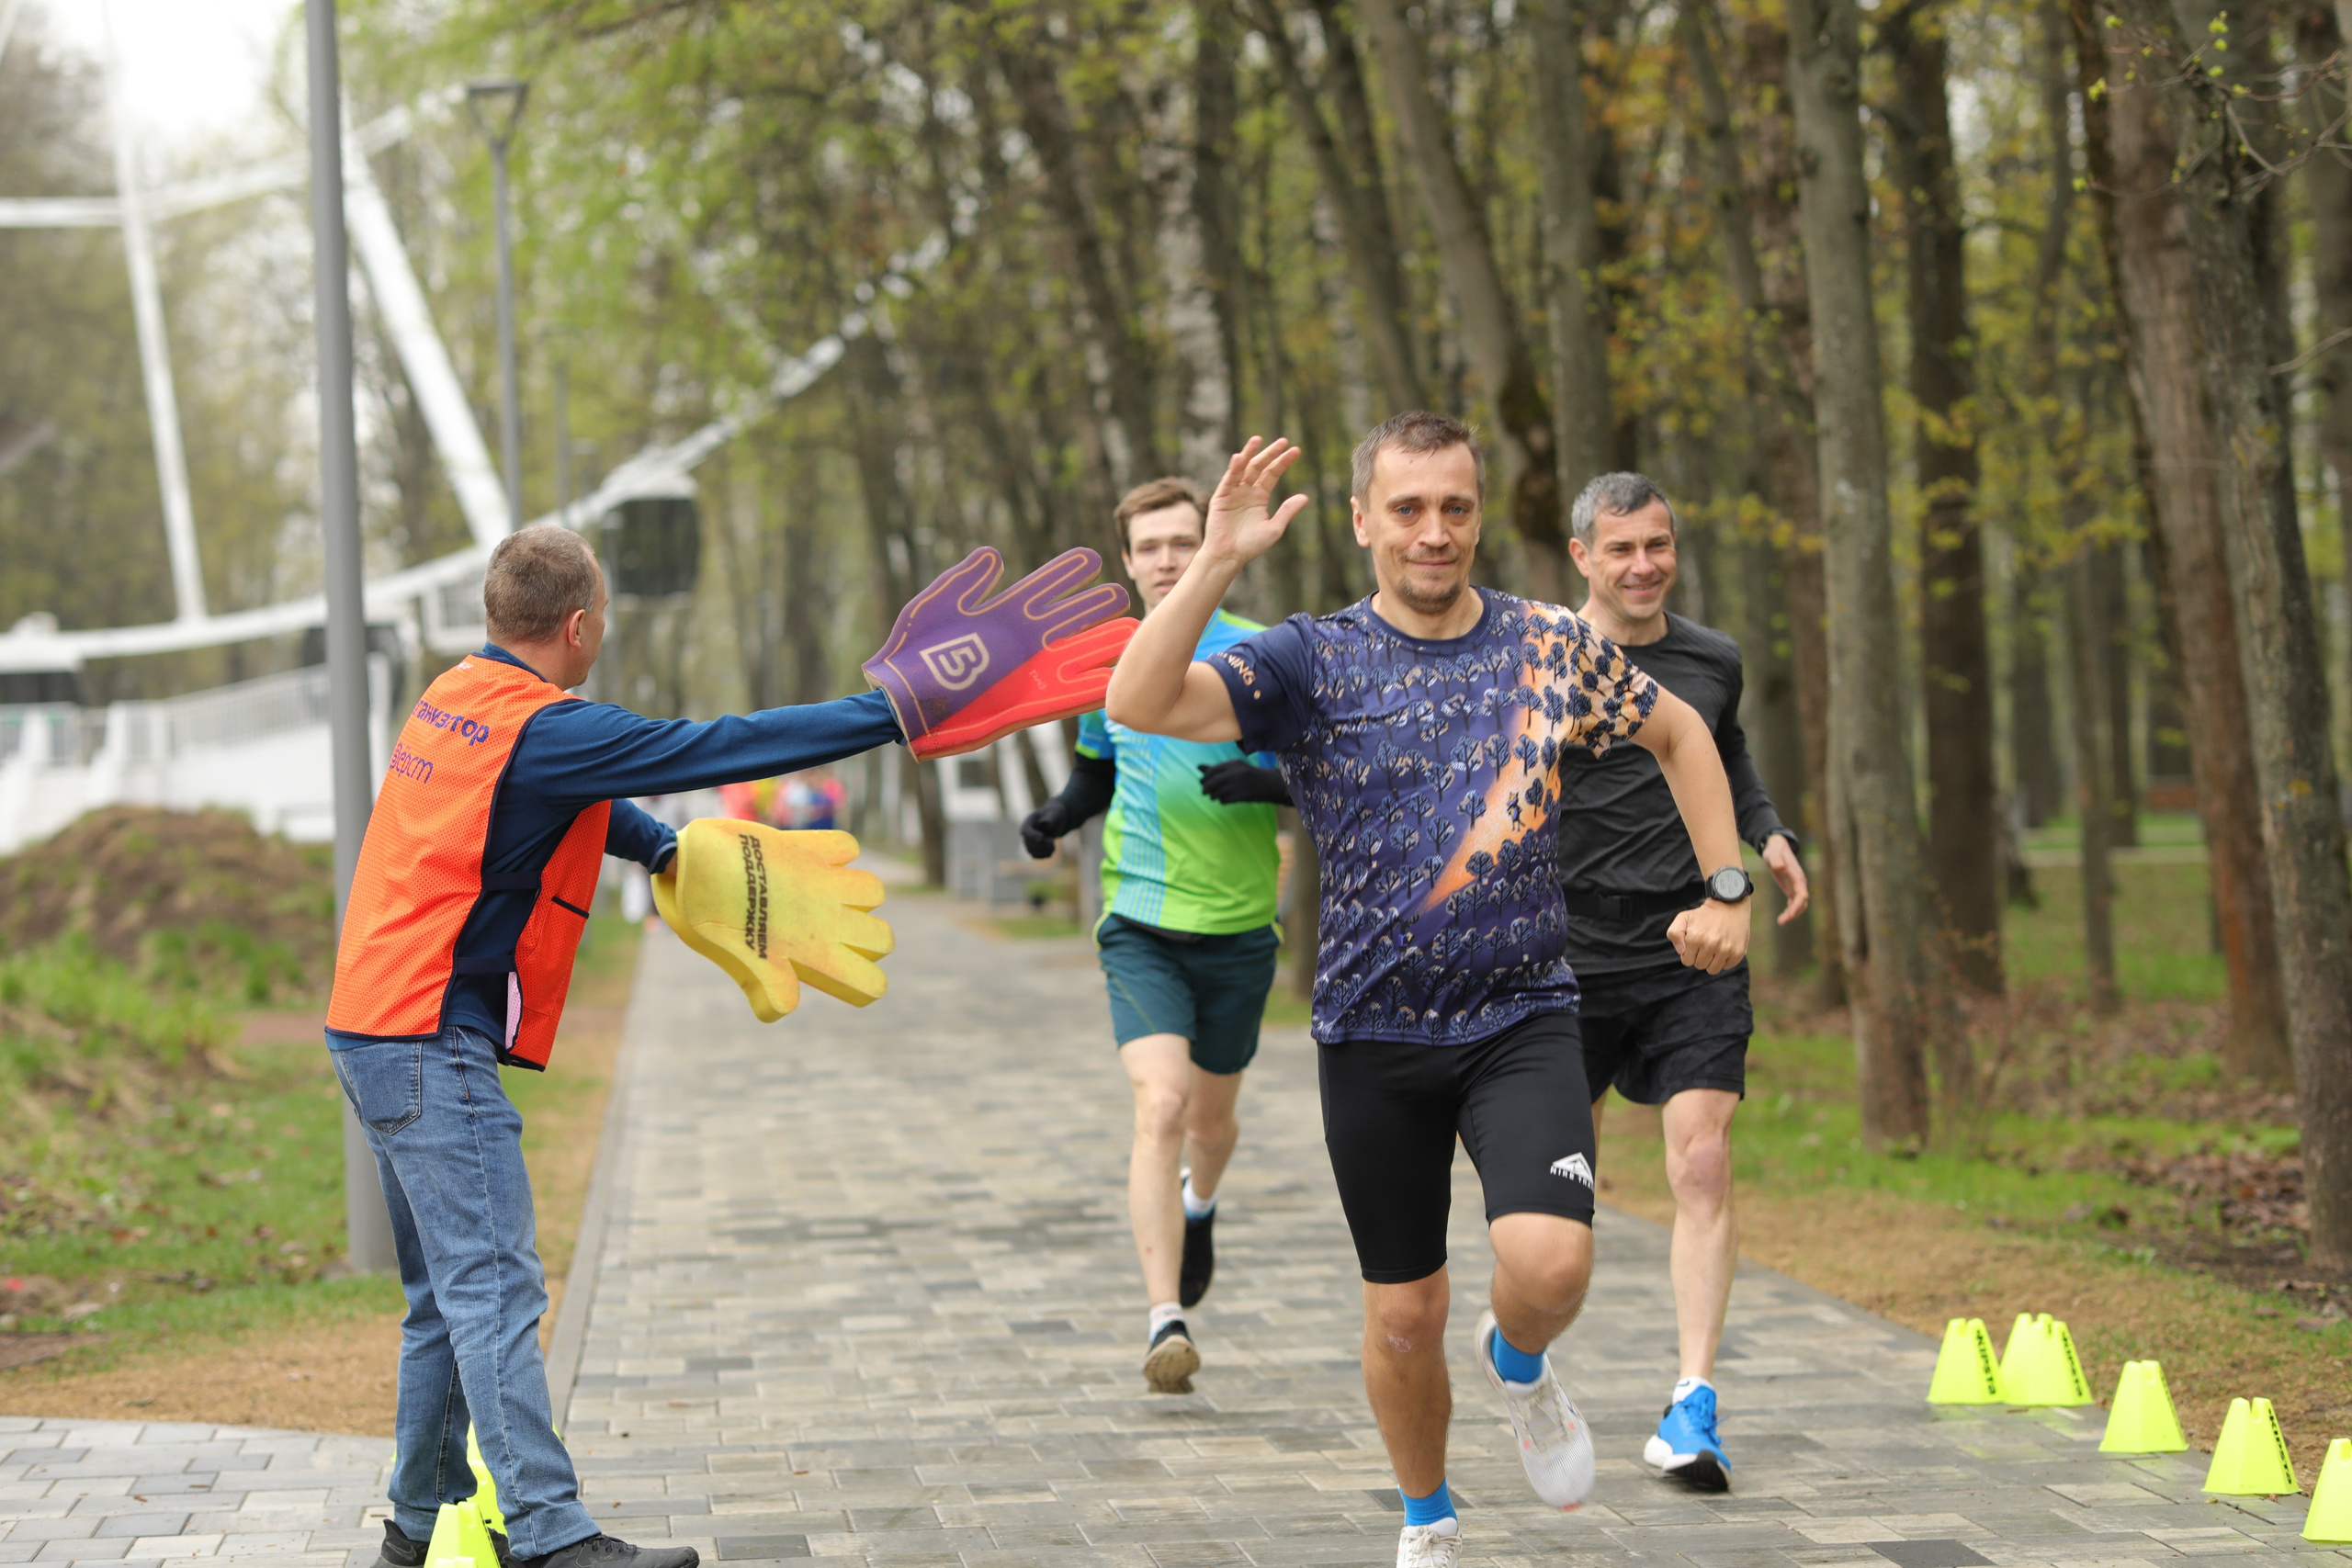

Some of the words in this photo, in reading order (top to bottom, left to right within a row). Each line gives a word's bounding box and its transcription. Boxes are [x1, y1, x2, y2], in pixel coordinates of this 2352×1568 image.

[413, 700, 490, 746] ганизтор
[739, 833, 757, 951] ПОДДЕРЖКУ
[749, 834, 768, 959] ДОСТАВЛЯЕМ
